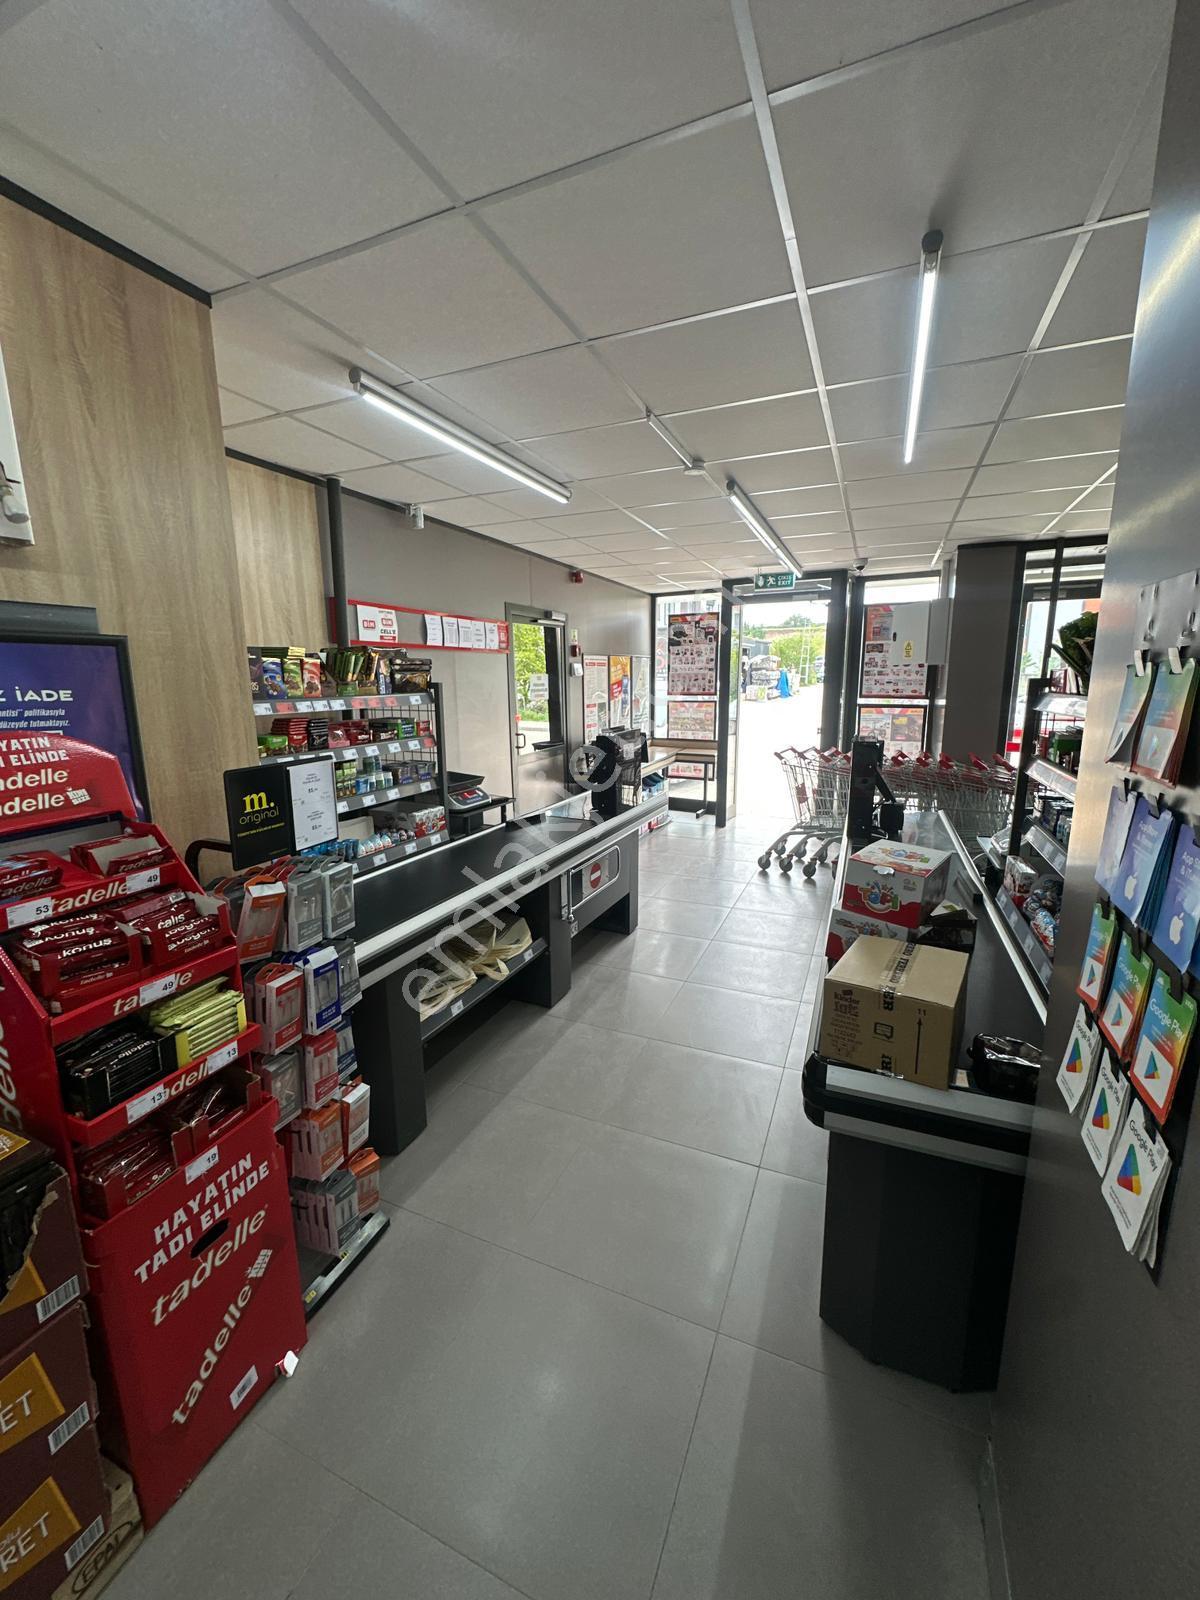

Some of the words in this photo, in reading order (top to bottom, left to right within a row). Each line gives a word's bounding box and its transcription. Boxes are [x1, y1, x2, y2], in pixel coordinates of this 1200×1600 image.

[15, 686, 74, 702] İADE
[9, 749, 70, 766] ELİNDE
[0, 792, 65, 816] delle
[239, 806, 280, 825] original
[147, 874, 158, 883] 49
[35, 904, 50, 915] 53
[162, 981, 174, 991] 49
[1149, 998, 1171, 1026] Google
[226, 1047, 237, 1058] 13
[1130, 1119, 1148, 1153] Google
[207, 1153, 217, 1163] 19
[153, 1152, 253, 1245] HAYATIN
[133, 1228, 194, 1284] TADI
[199, 1160, 270, 1233] ELİNDE
[151, 1209, 266, 1326] tadelle
[171, 1284, 252, 1425] tadelle
